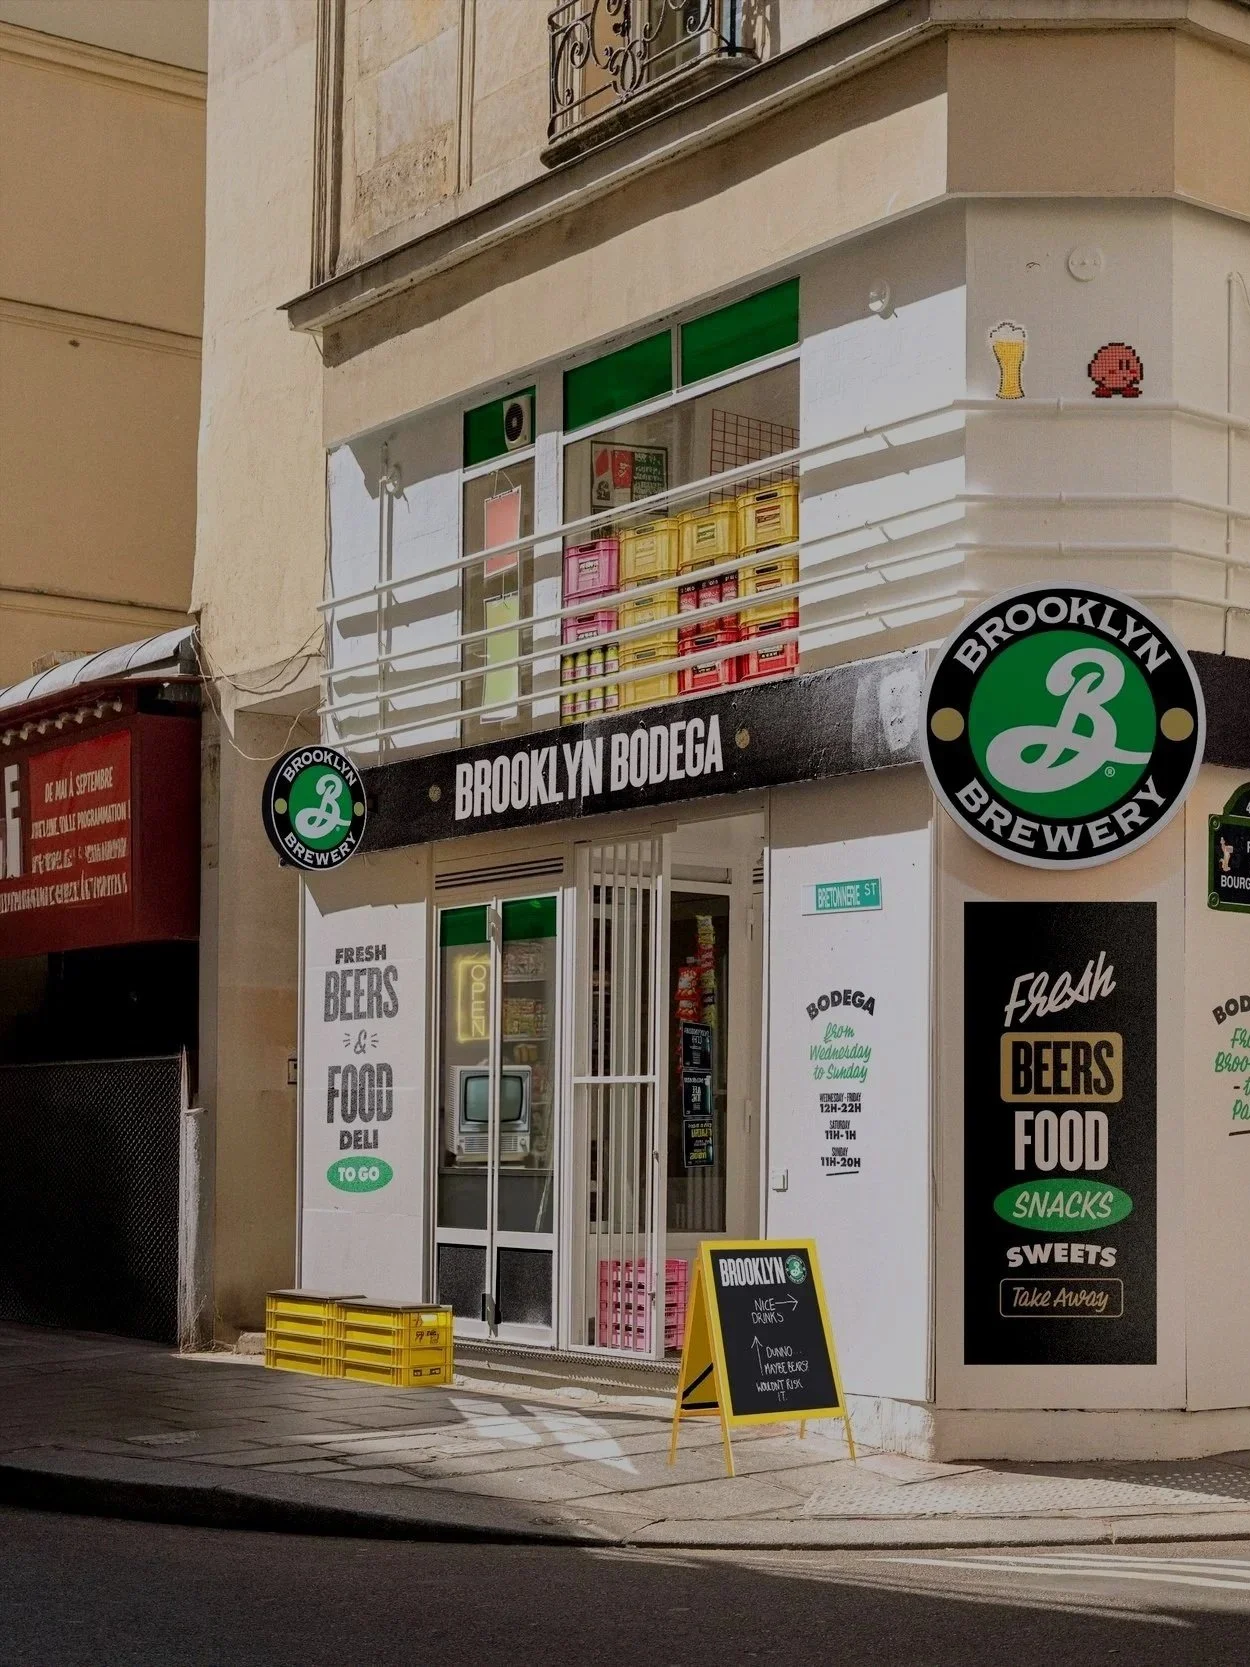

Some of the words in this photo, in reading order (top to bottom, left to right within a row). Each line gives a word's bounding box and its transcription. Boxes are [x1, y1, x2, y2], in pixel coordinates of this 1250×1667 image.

[953, 597, 1171, 673] BROOKLYN
[283, 750, 357, 787] BROOKLYN
[455, 736, 603, 820] BROOKLYN
[610, 715, 724, 791] BODEGA
[44, 782, 54, 803] DE
[55, 779, 67, 801] MAI
[75, 766, 113, 796] SEPTEMBRE
[955, 775, 1166, 852] BREWERY
[284, 832, 356, 865] BREWERY
[864, 883, 877, 896] ST
[335, 944, 387, 965] FRESH
[324, 965, 399, 1022] BEERS
[470, 964, 487, 1038] OPEN
[1004, 950, 1117, 1028] Fresh
[806, 989, 876, 1021] BODEGA
[353, 1029, 368, 1055] &
[810, 1043, 871, 1063] Wednesday
[813, 1065, 825, 1080] to
[826, 1063, 868, 1083] Sunday
[1012, 1039, 1114, 1096] BEERS
[326, 1062, 393, 1123] FOOD
[819, 1093, 844, 1102] WEDNESDAY
[847, 1092, 861, 1102] FRIDAY
[820, 1103, 861, 1113] 12H-22H
[829, 1120, 850, 1129] SATURDAY
[339, 1129, 379, 1150] DELI
[832, 1147, 848, 1156] SUNDAY
[1014, 1110, 1109, 1171] FOOD
[338, 1166, 356, 1182] TO
[357, 1166, 380, 1181] GO
[821, 1157, 861, 1167] 11H-20H
[1012, 1191, 1112, 1219] SNACKS
[1006, 1242, 1118, 1267] SWEETS
[719, 1257, 786, 1287] BROOKLYN
[754, 1298, 776, 1312] NICE
[1012, 1286, 1051, 1308] Take
[1053, 1288, 1110, 1312] Away
[751, 1312, 784, 1324] DRINKS
[764, 1362, 788, 1375] MAYBE
[785, 1379, 803, 1390] RISK
